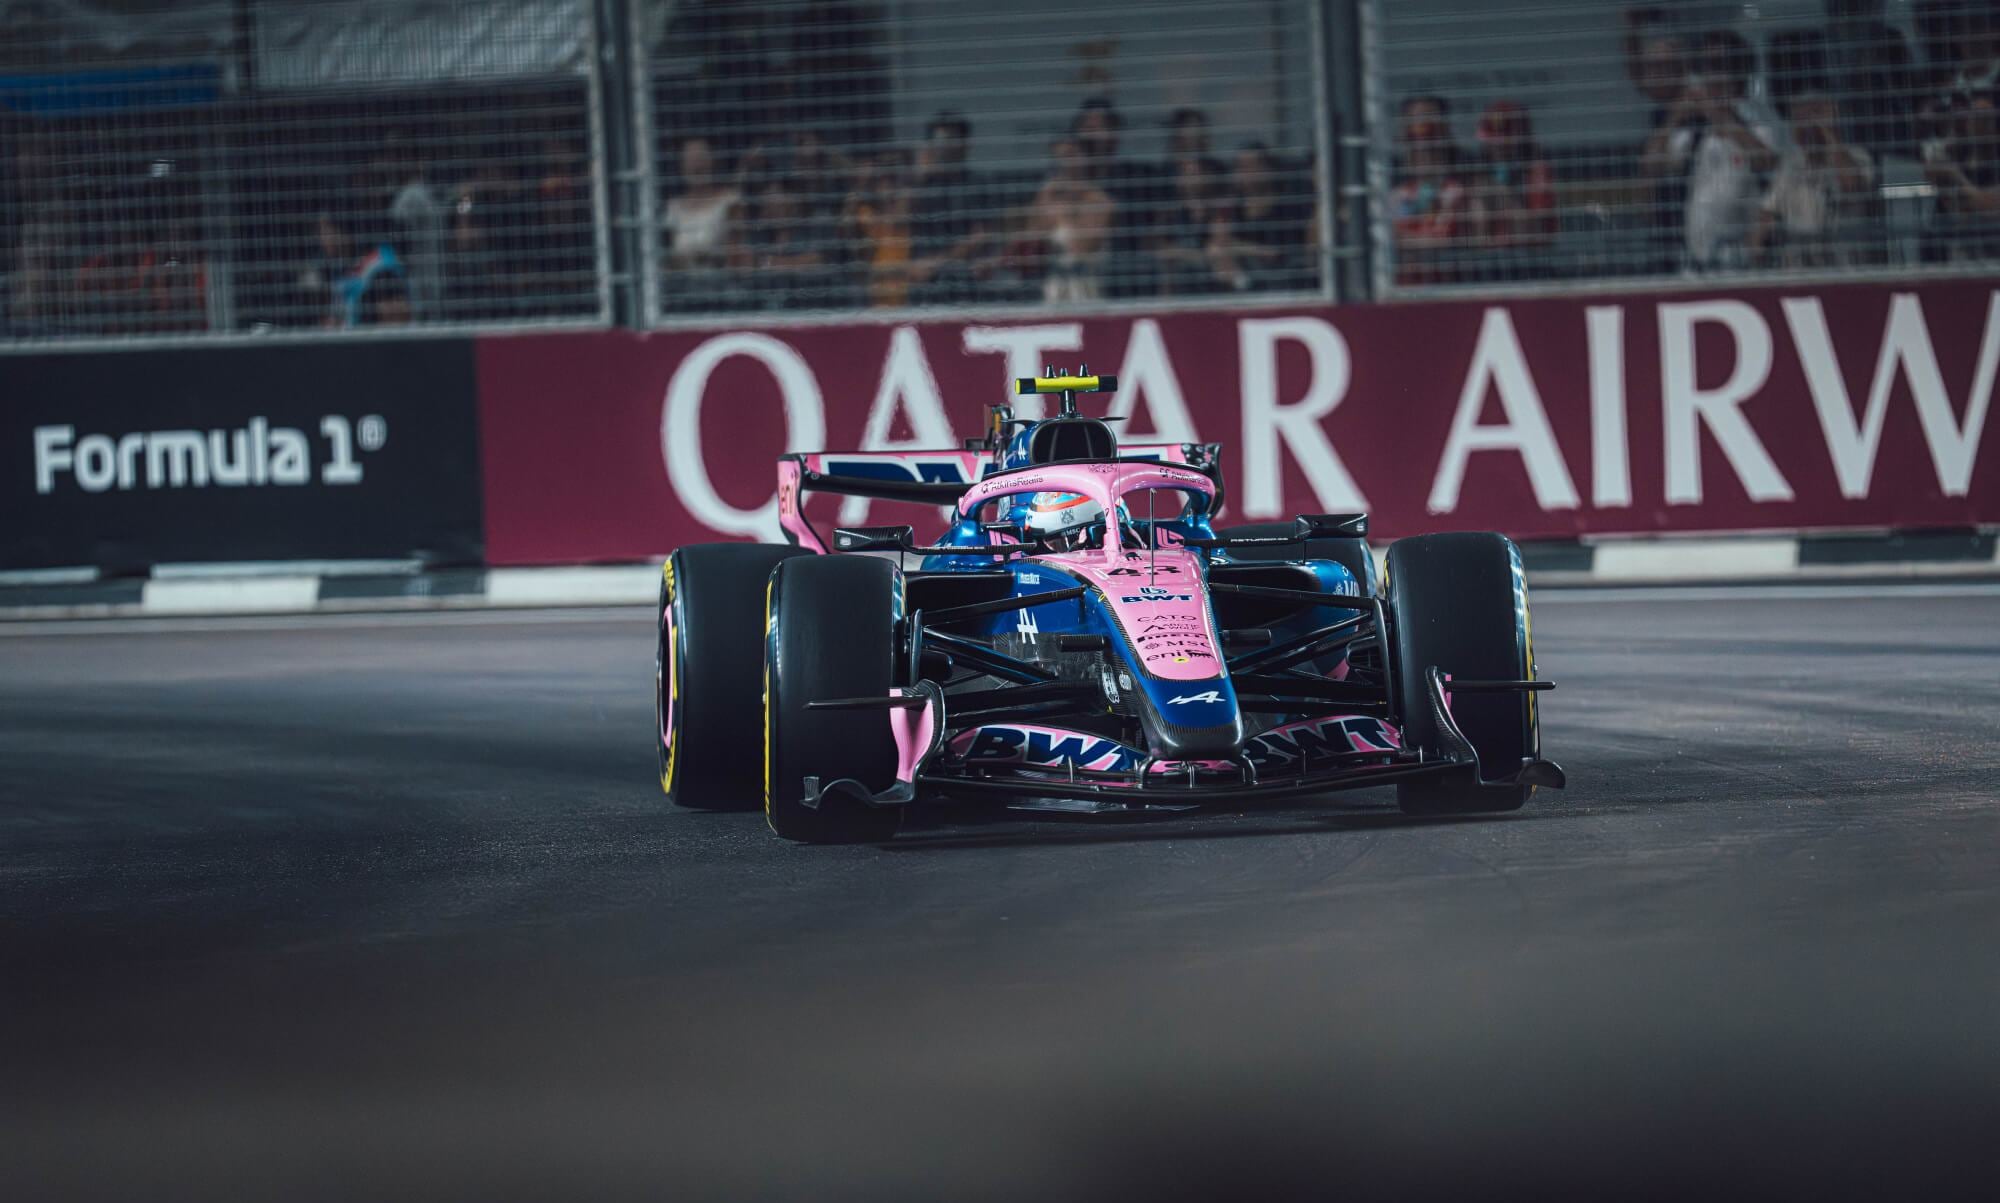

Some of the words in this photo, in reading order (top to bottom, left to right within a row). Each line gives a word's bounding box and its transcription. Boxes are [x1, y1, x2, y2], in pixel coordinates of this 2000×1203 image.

[34, 416, 311, 494] Formula
[1107, 566, 1182, 576] 43
[1121, 594, 1192, 604] BWT
[1137, 614, 1197, 623] CATO
[1167, 640, 1211, 648] MSC
[1146, 651, 1182, 662] eni
